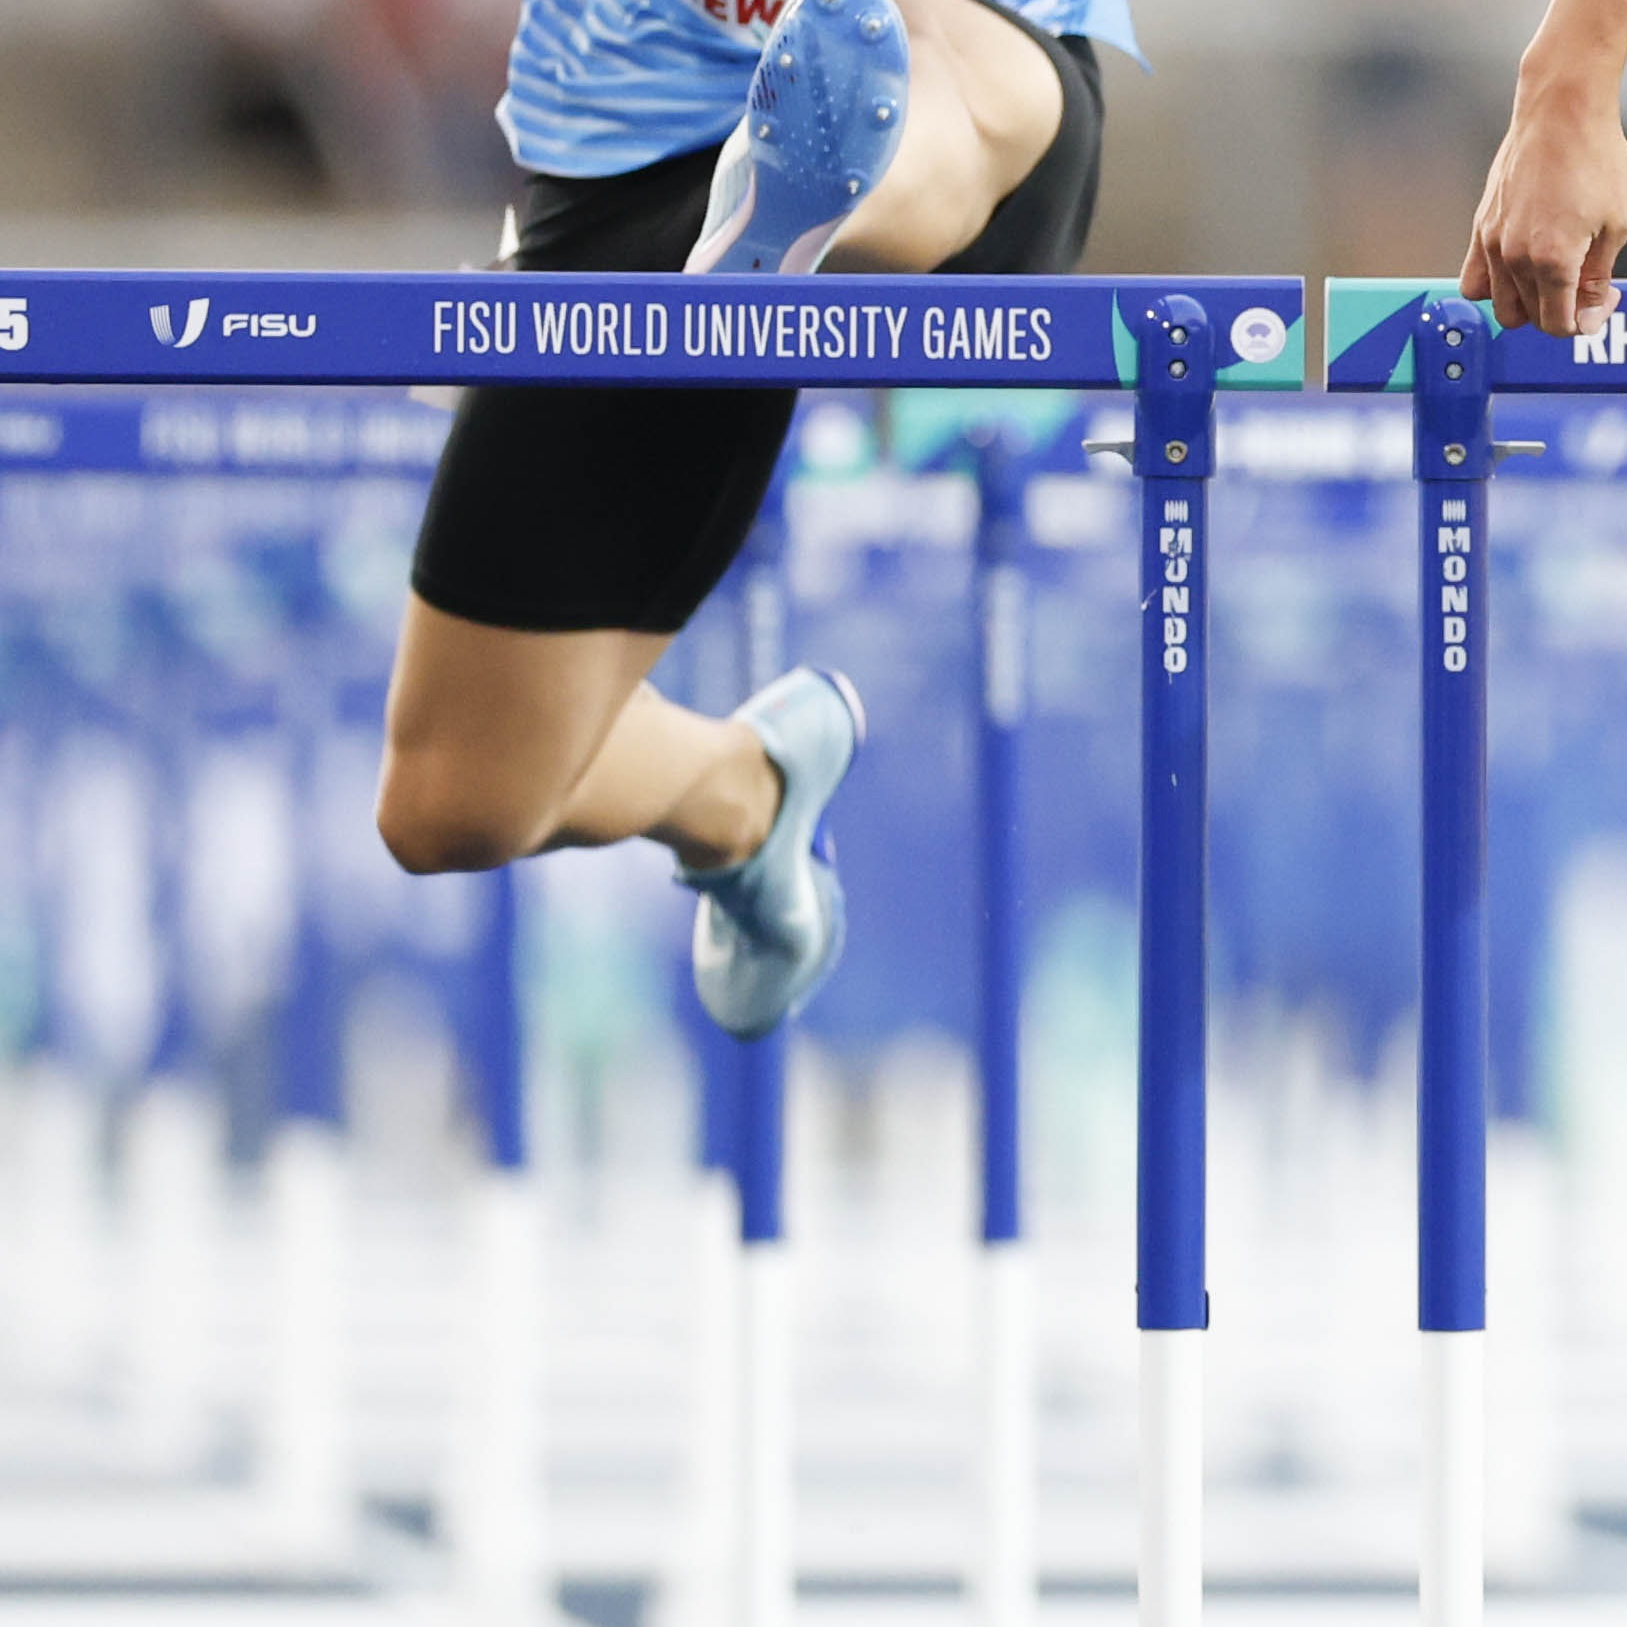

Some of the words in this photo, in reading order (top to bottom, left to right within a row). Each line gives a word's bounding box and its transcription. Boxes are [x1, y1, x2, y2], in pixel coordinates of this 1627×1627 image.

[223, 313, 316, 338] FISU
[434, 301, 516, 354] FISU
[532, 302, 668, 356] WORLD
[684, 304, 908, 359] UNIVERSITY
[923, 307, 1052, 361] GAMES
[1160, 527, 1193, 674] MONDO
[1438, 526, 1470, 672] MONDO
